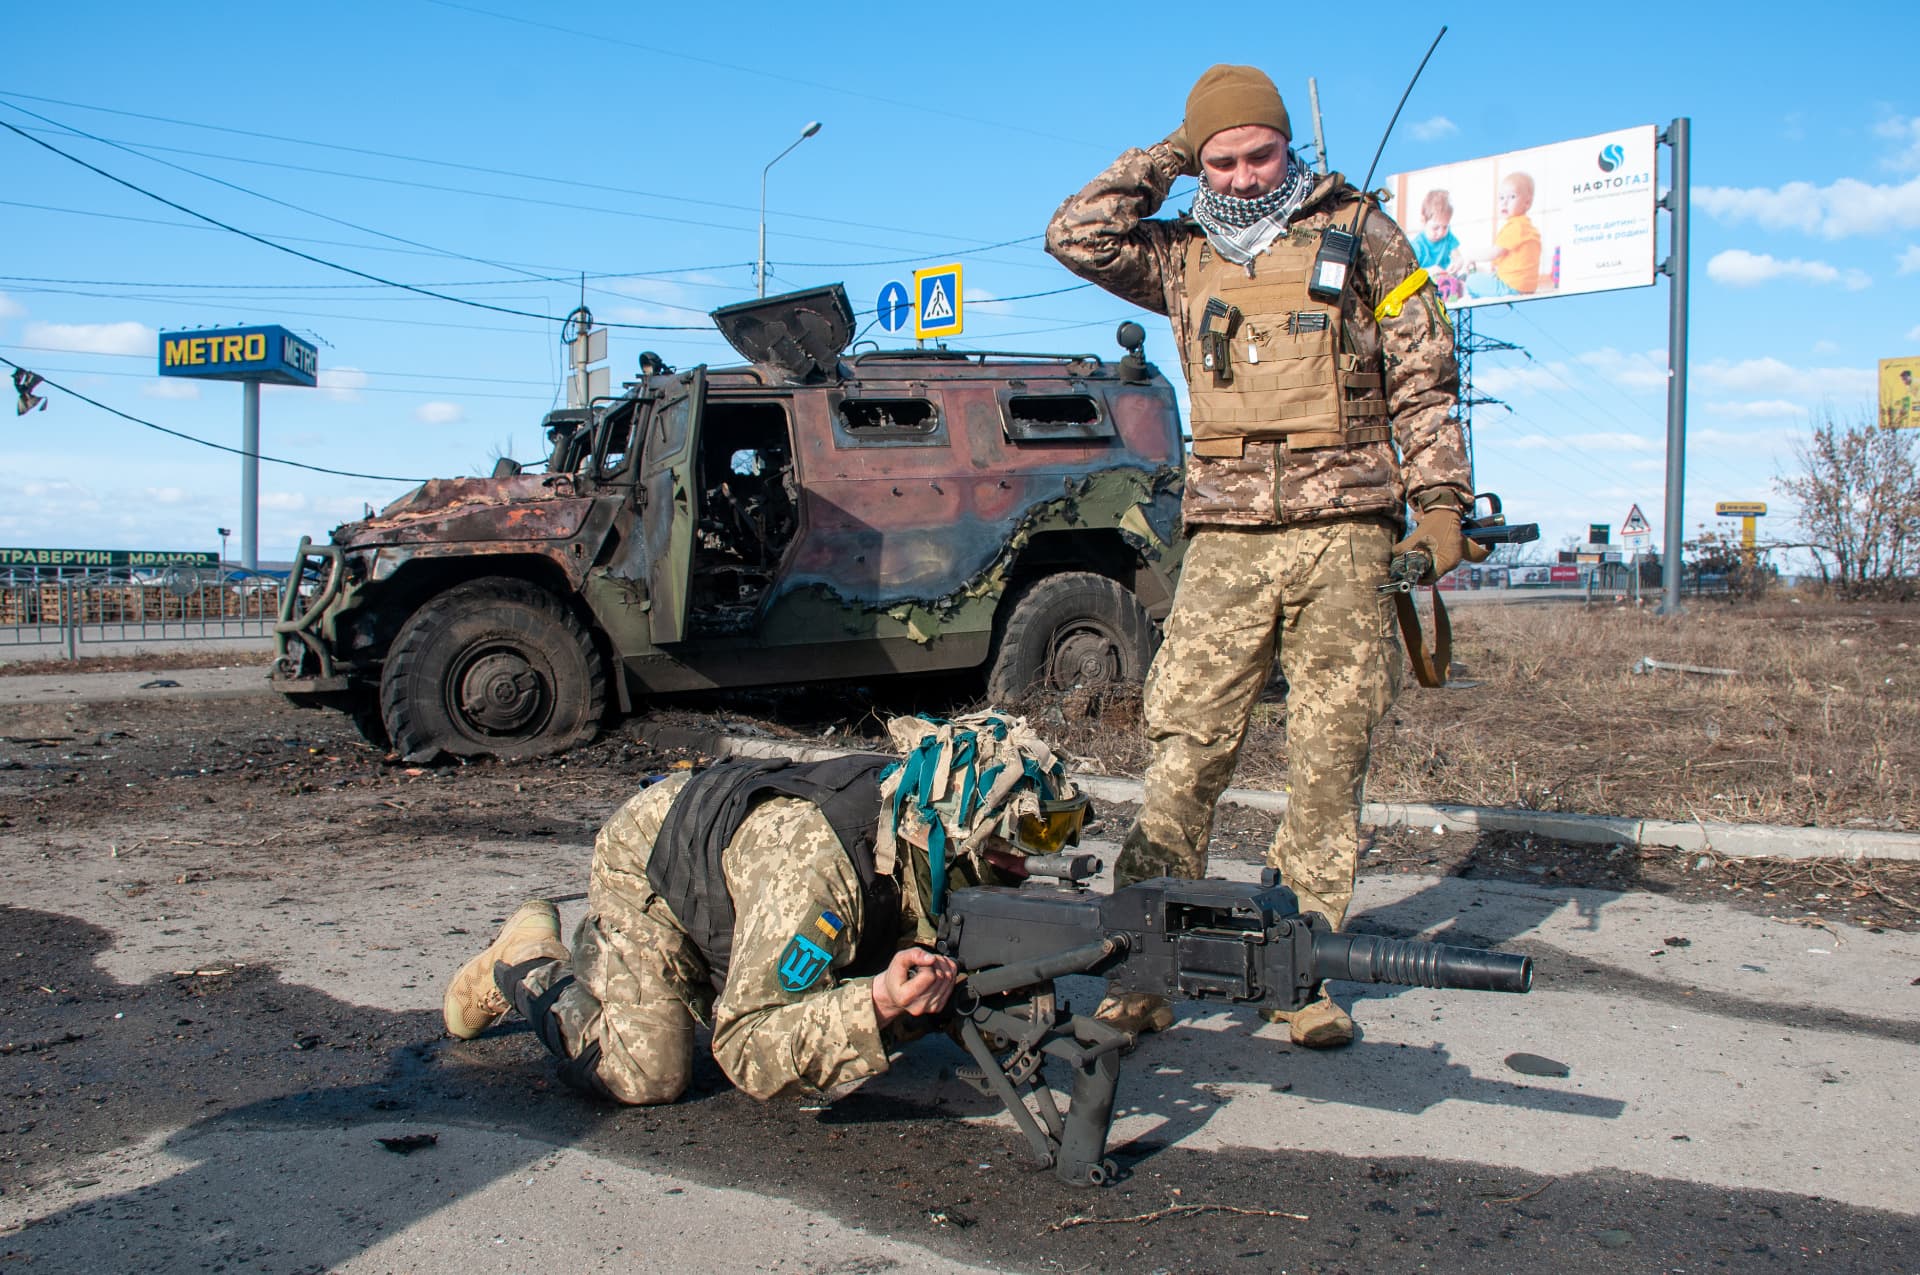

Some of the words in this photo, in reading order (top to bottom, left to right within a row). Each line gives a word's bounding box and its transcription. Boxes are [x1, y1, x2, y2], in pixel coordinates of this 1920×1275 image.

[1573, 173, 1649, 194] НАФТОГАЗ
[165, 333, 266, 367] METRO
[283, 336, 317, 377] METRO
[0, 549, 113, 565] ТРАВЕРТИН
[129, 552, 208, 566] МРАМОР
